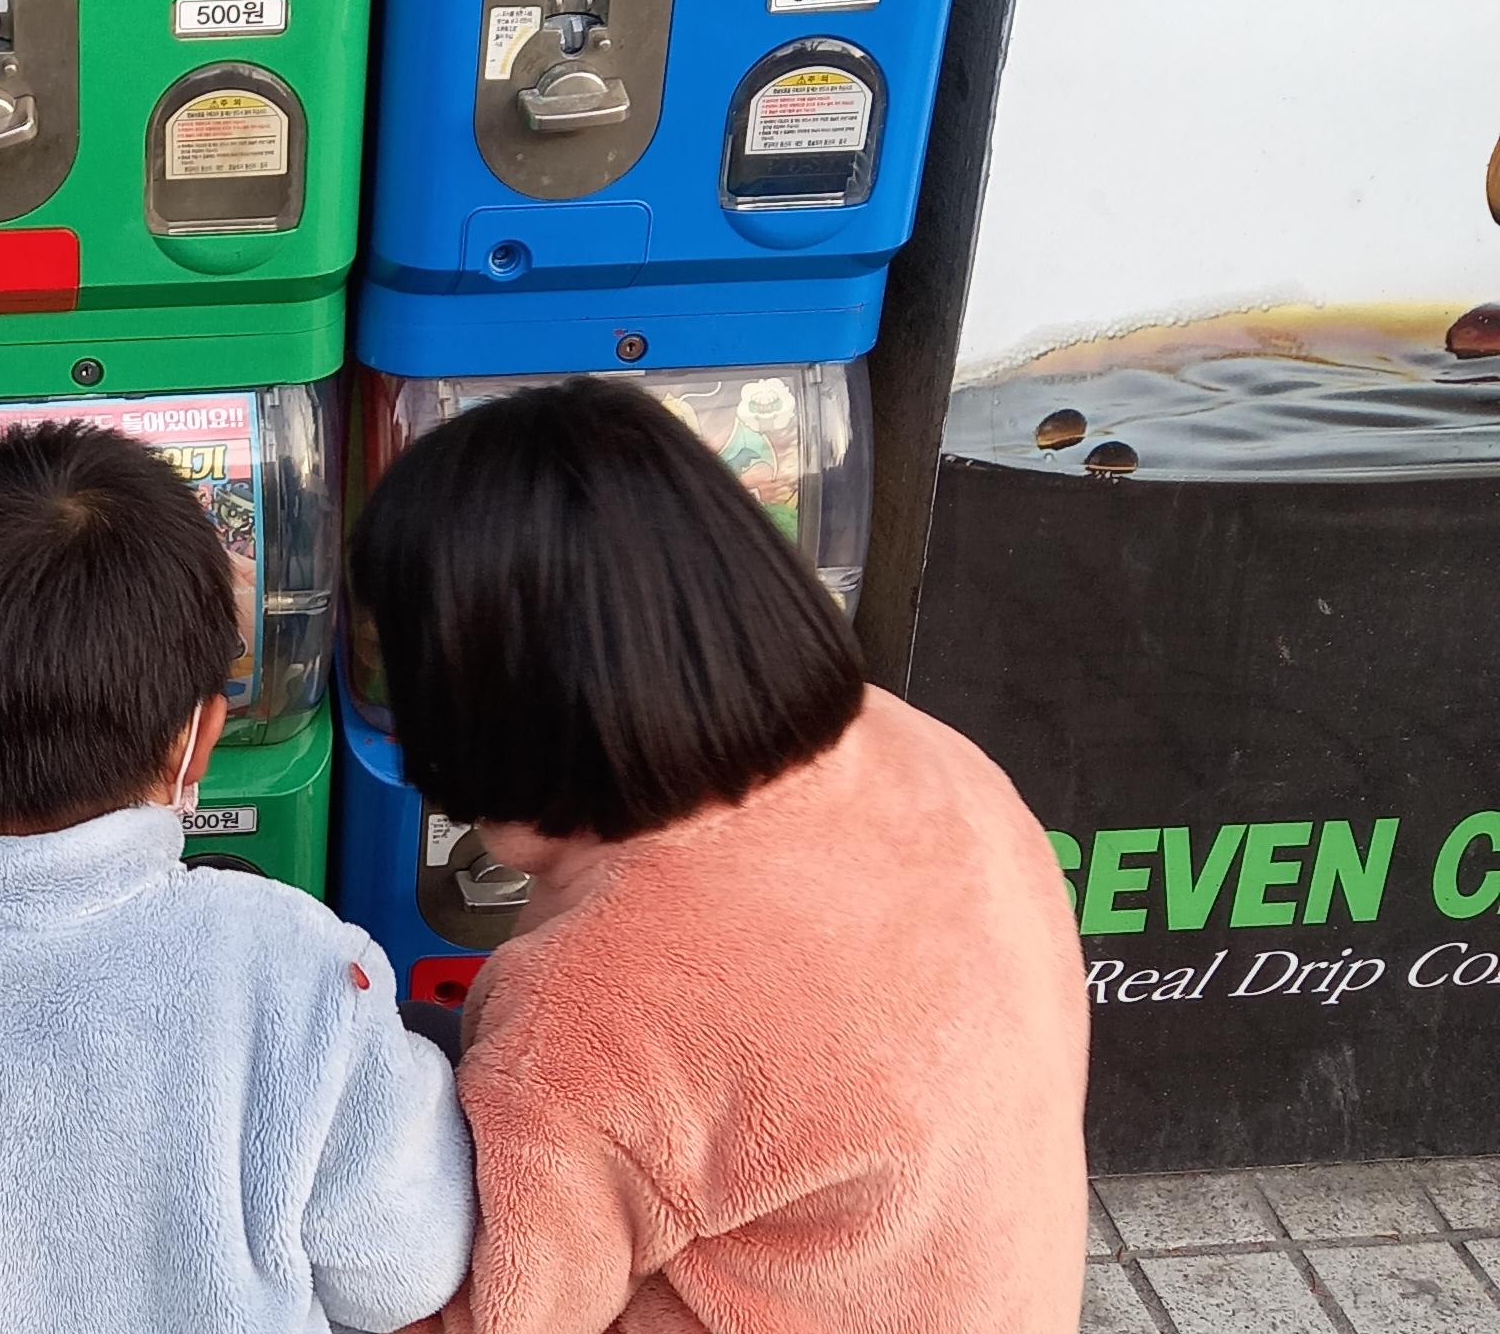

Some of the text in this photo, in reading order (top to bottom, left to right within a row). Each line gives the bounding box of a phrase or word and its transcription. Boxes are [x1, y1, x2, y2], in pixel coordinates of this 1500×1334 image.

[196, 1, 264, 25] 500원
[121, 407, 244, 435] 들어있어요!!
[181, 811, 240, 830] 500원
[1085, 949, 1229, 1005] Real
[1227, 947, 1387, 1007] Drip
